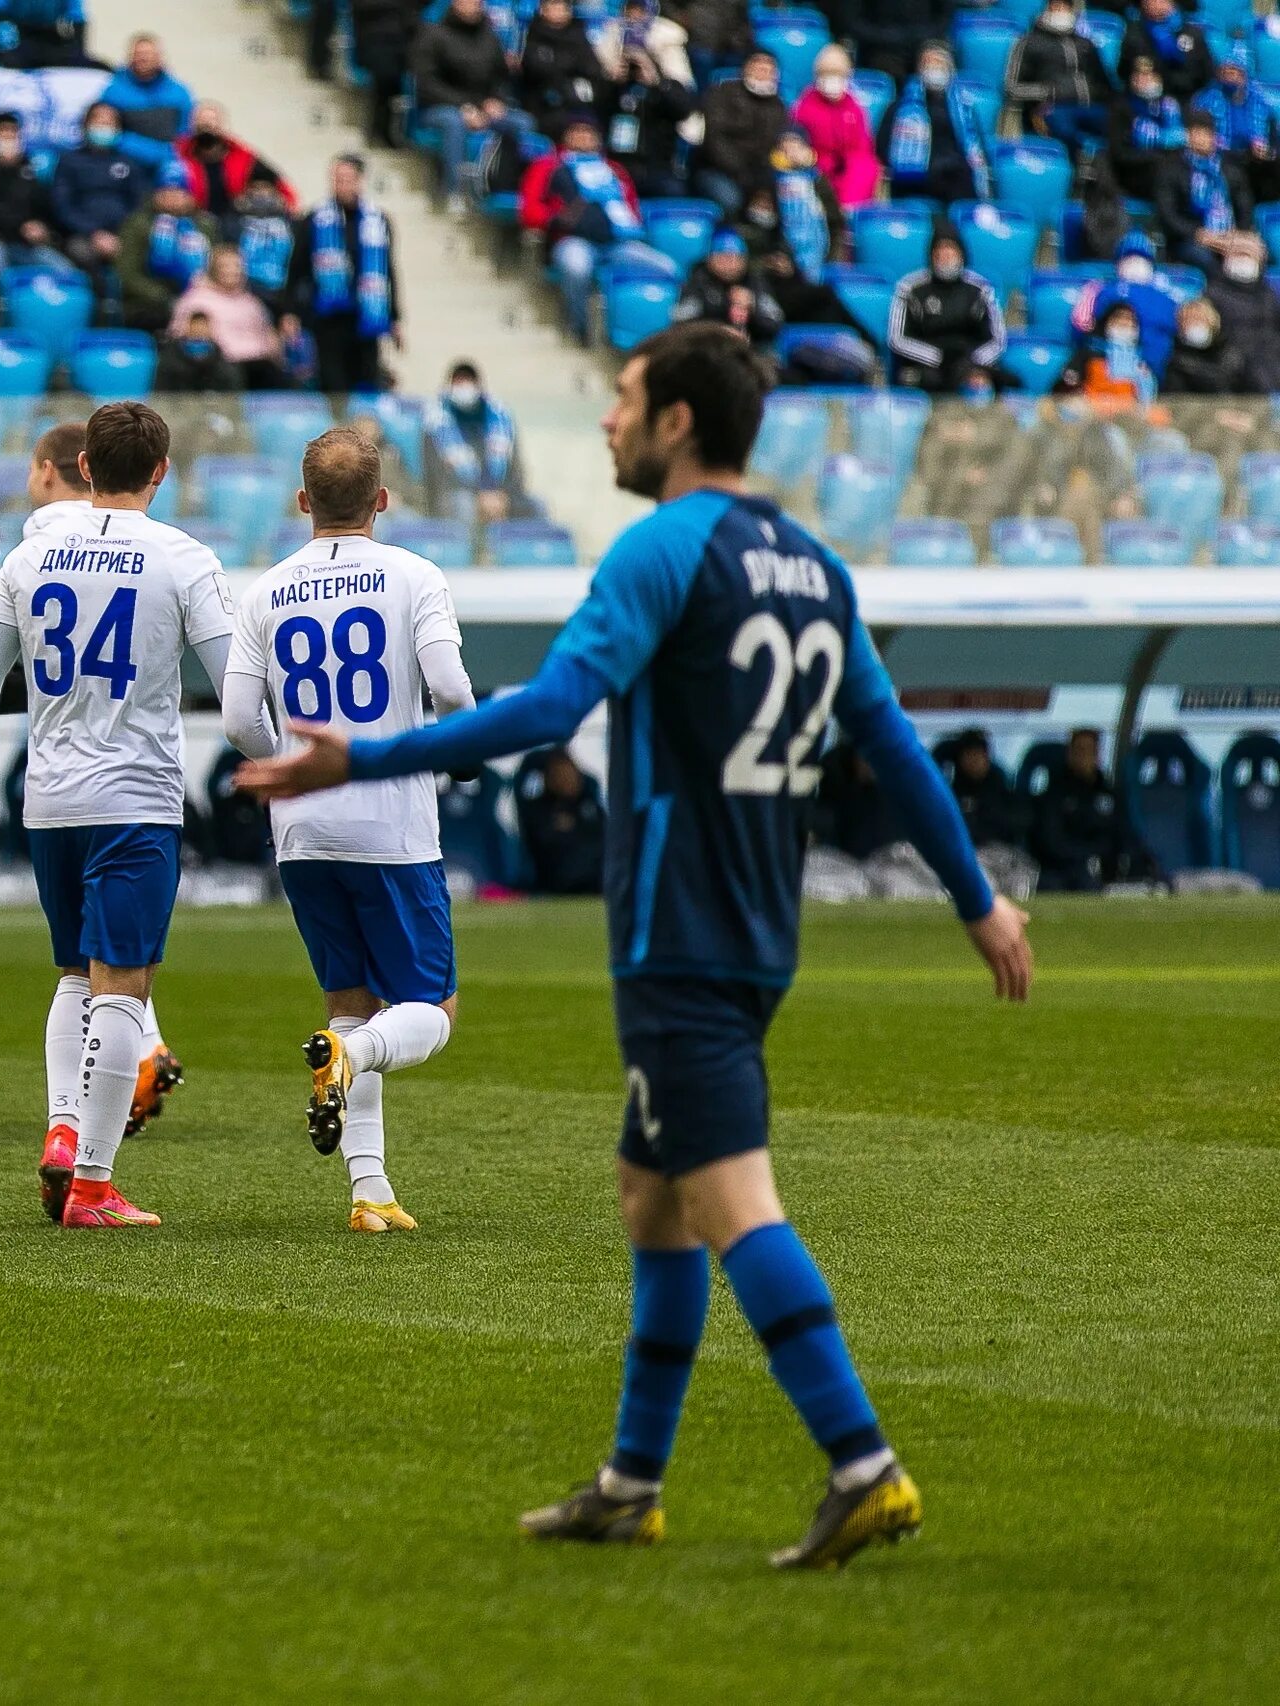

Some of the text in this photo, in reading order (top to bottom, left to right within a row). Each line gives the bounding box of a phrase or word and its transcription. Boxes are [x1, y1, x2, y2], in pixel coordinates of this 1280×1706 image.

[39, 548, 145, 575] ДМИТРИЕВ
[271, 568, 385, 610] МАСТЕРНОЙ
[31, 581, 138, 700] 34
[274, 606, 390, 726] 88
[722, 611, 844, 797] 22
